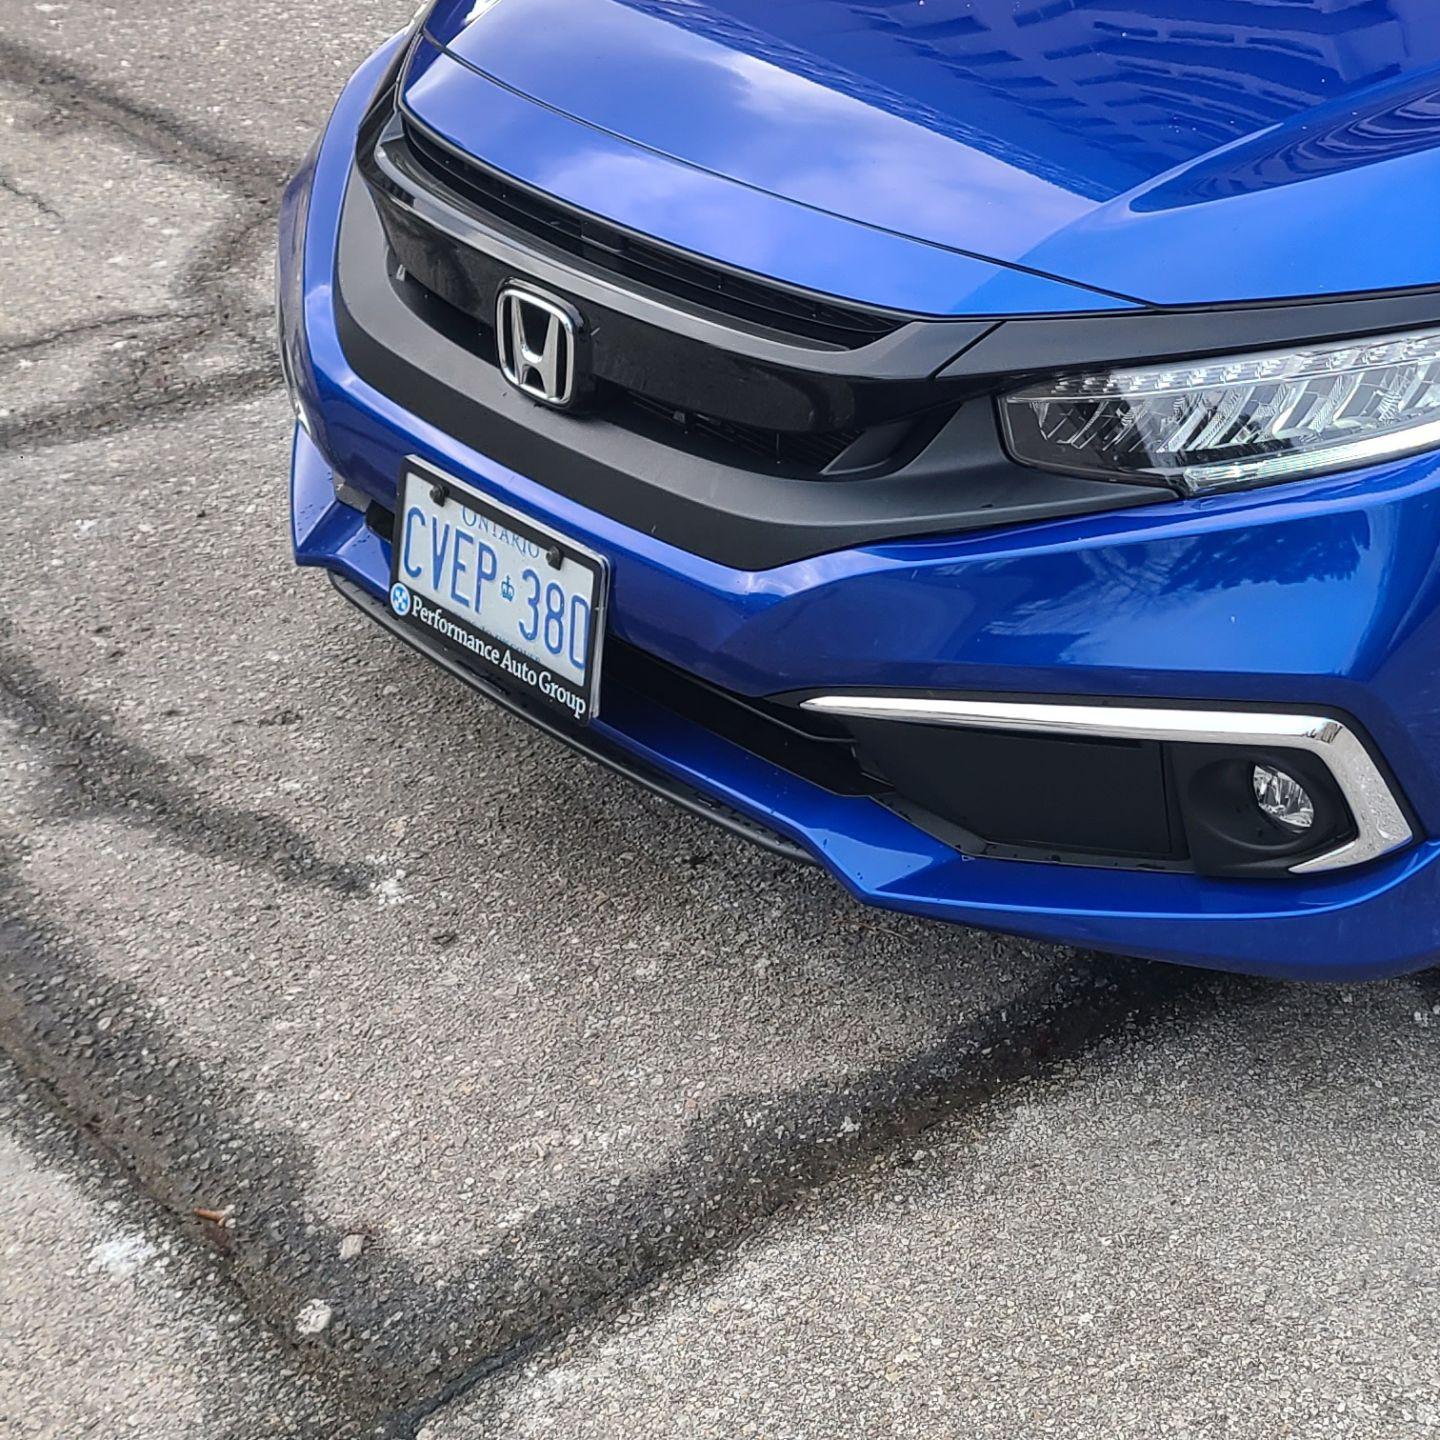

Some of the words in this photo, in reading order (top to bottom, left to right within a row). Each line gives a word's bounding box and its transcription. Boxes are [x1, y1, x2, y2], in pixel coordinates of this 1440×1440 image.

[404, 507, 497, 614] CVEP
[519, 568, 590, 670] 380
[412, 595, 500, 665] Performance
[500, 649, 537, 686] Auto
[538, 671, 586, 719] Group
